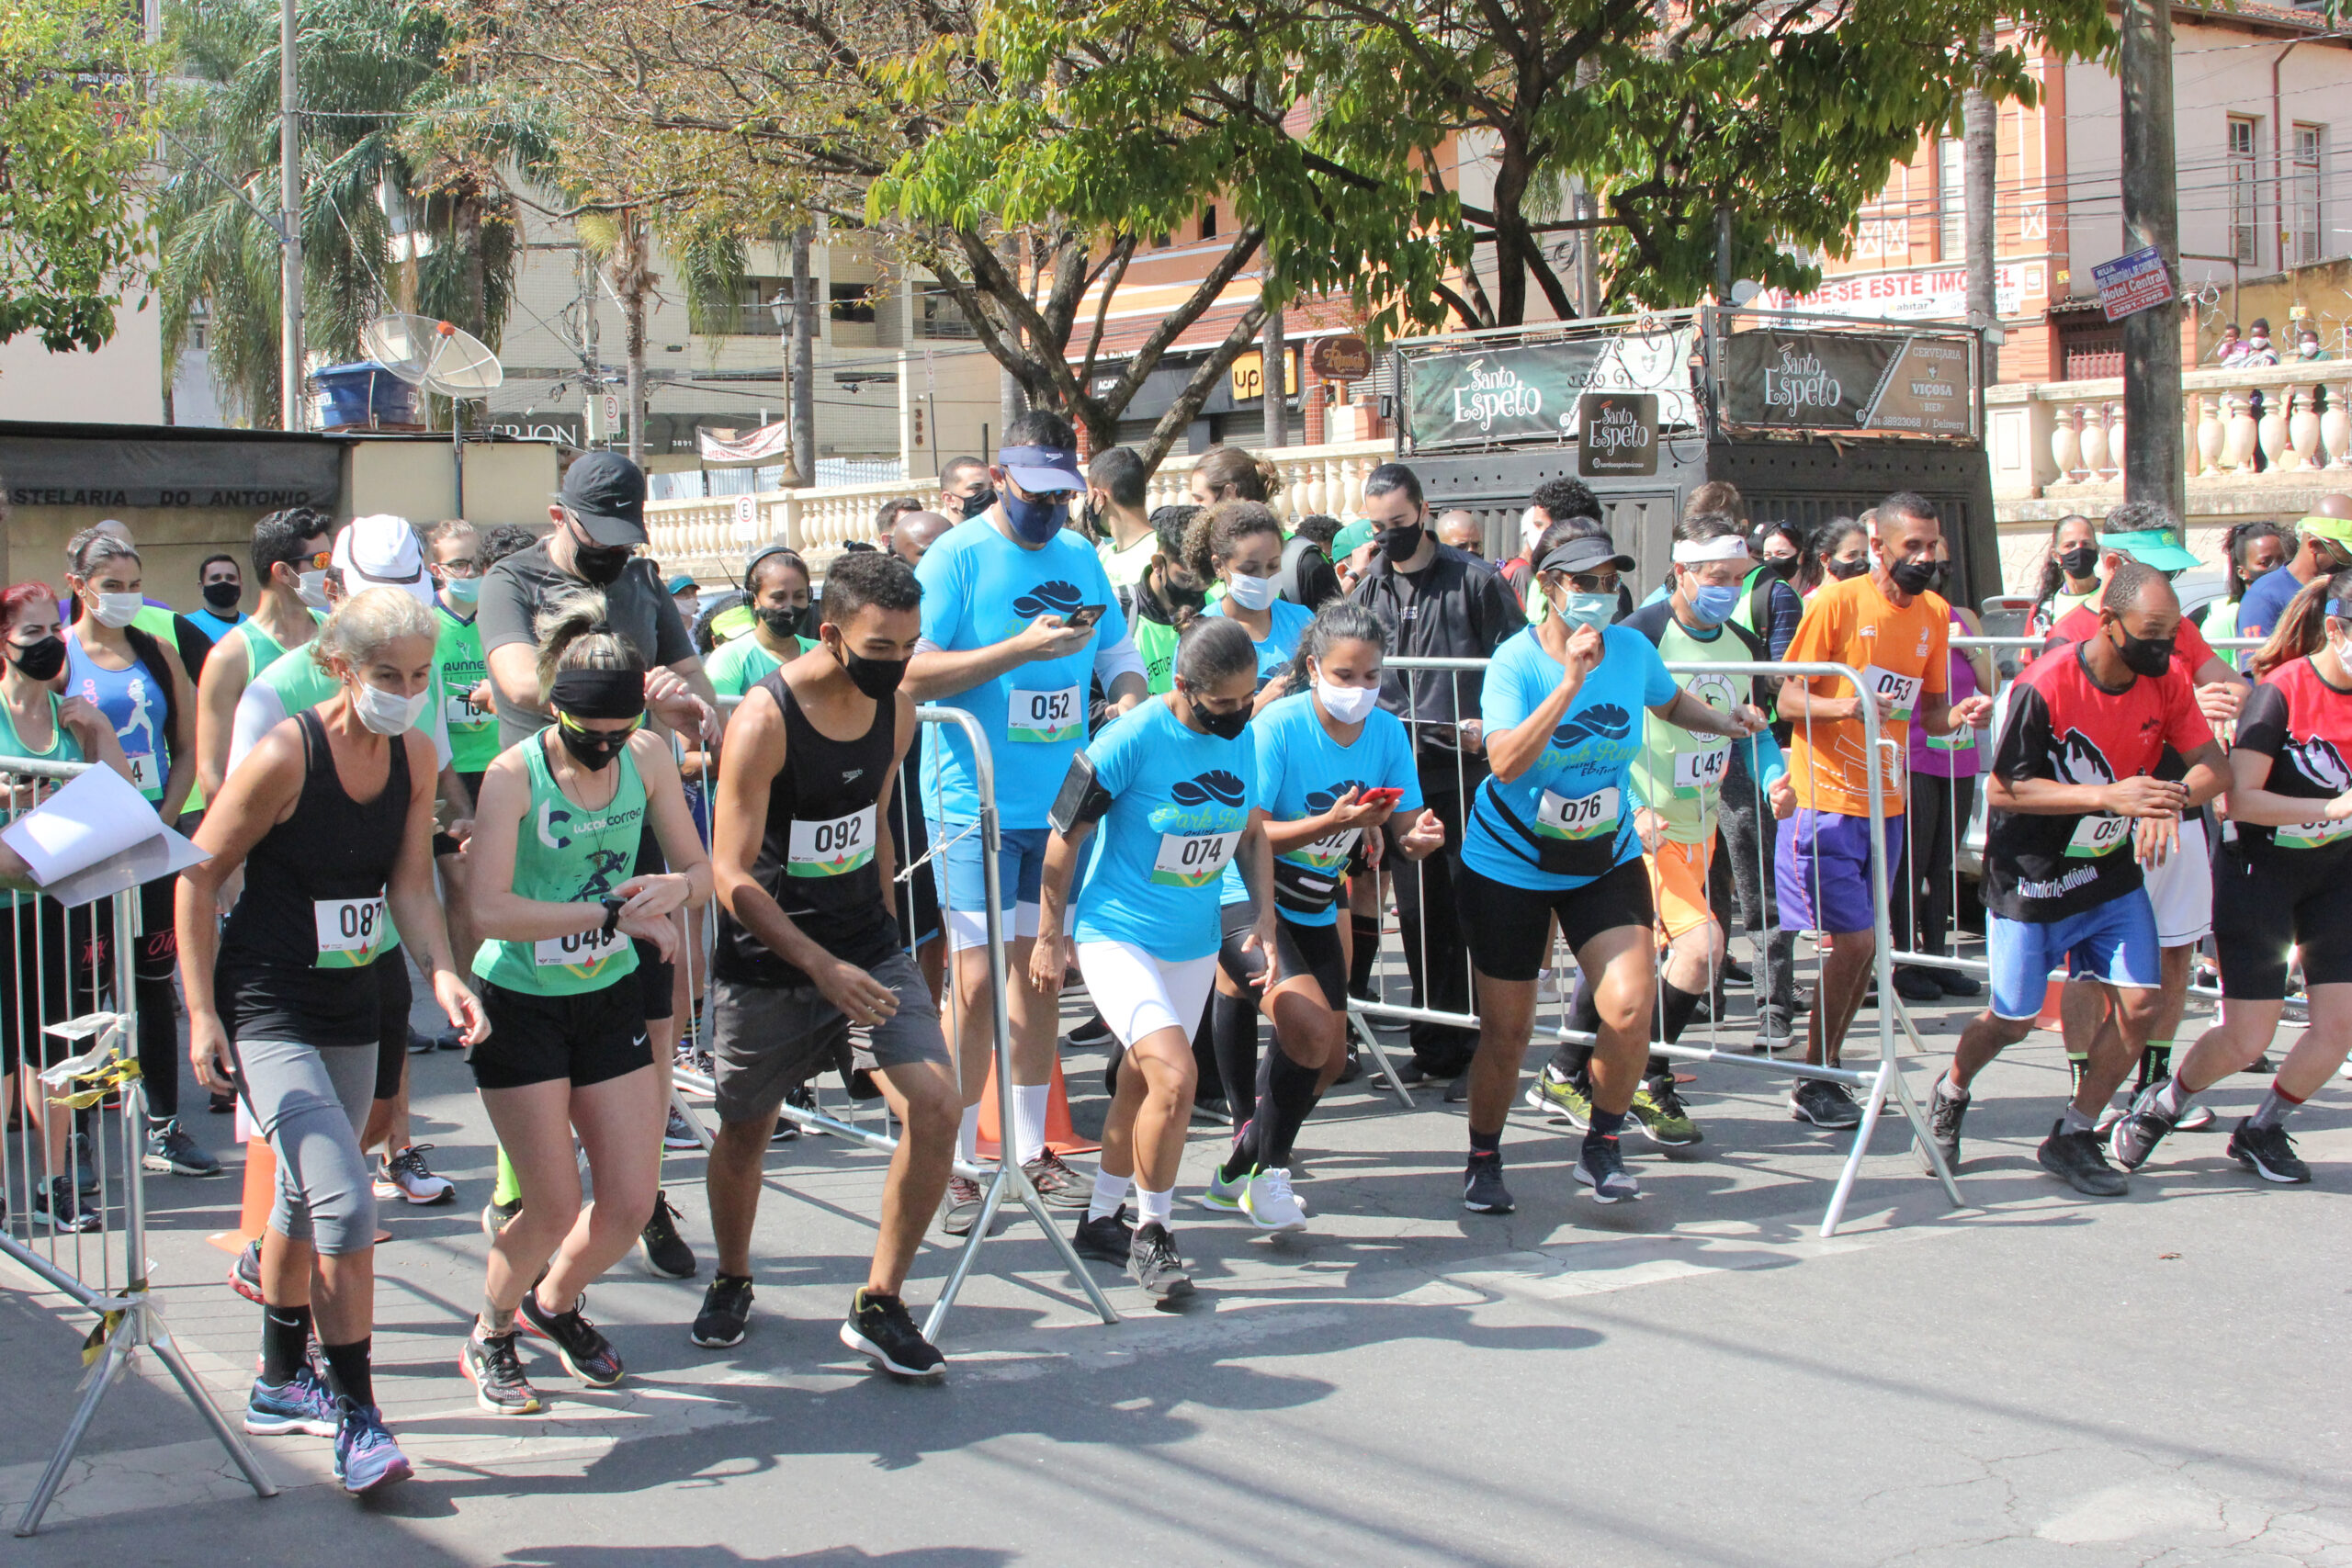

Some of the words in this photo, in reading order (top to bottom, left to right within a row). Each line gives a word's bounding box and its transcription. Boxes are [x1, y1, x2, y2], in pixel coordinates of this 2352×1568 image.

[2097, 265, 2116, 277] RUA
[1870, 272, 1924, 299] ESTE
[2101, 283, 2128, 301] Hotel
[2128, 269, 2165, 292] Central
[1781, 352, 1822, 377] Santo
[1912, 347, 1962, 361] CERVEJARIA
[1471, 366, 1516, 391] Santo
[1911, 383, 1953, 397] VIÇOSA
[1453, 379, 1542, 432] Espeto
[1764, 367, 1842, 418] Espeto
[1601, 407, 1634, 425] Santo
[1924, 403, 1941, 412] BIER
[1589, 419, 1649, 457] Espeto
[1933, 418, 1964, 432] Delivery
[7, 488, 128, 505] STELARIA
[159, 490, 191, 505] DO
[209, 490, 311, 505] ANTONIO
[742, 503, 749, 518] E
[443, 660, 487, 672] RUNNE
[1877, 674, 1913, 702] 053
[1031, 692, 1069, 721] 052
[1537, 743, 1591, 771] Park
[1562, 761, 1598, 773] ONLINE
[1691, 751, 1724, 779] 043
[1581, 766, 1619, 777] EDITION
[1152, 802, 1214, 829] Park
[1560, 795, 1601, 823] 076
[814, 816, 862, 853] 092
[1182, 828, 1216, 838] ONLINE
[1181, 837, 1224, 866] 074
[339, 901, 383, 939] 087
